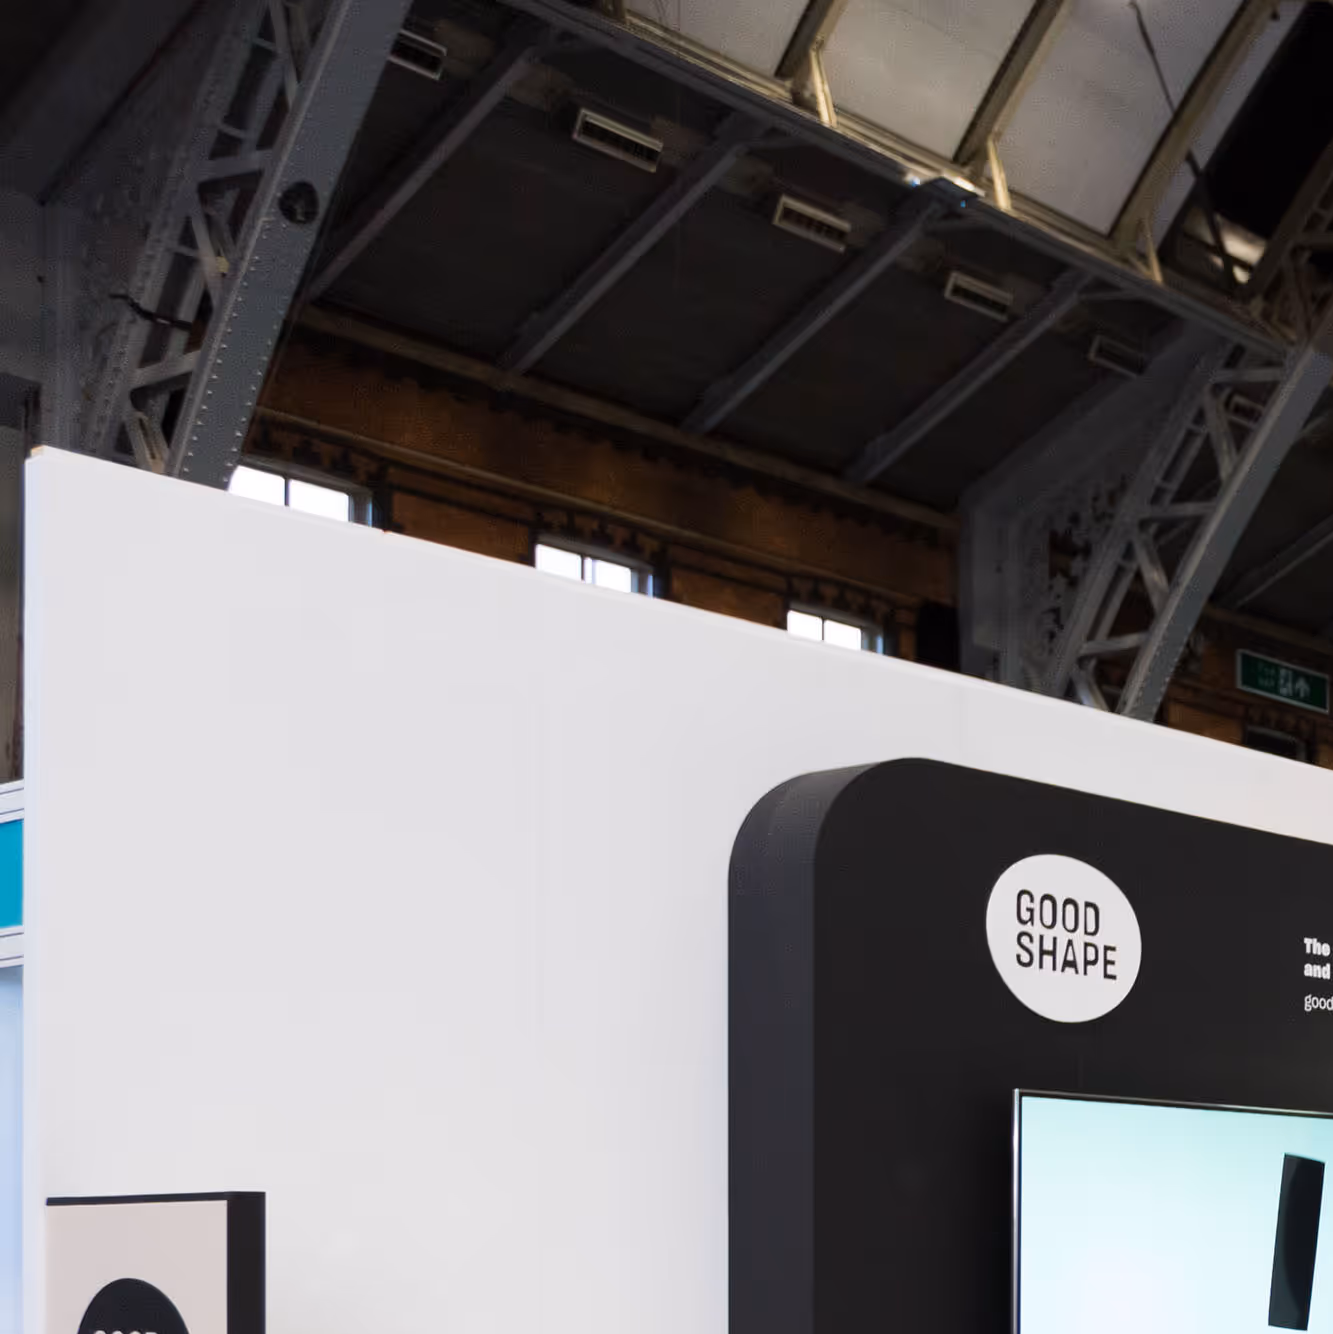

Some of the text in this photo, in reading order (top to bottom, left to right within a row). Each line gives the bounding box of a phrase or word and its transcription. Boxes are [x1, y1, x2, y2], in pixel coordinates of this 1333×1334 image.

[1016, 889, 1100, 937] GOOD
[1016, 931, 1117, 981] SHAPE
[1303, 937, 1331, 957] The
[1303, 962, 1331, 980] and
